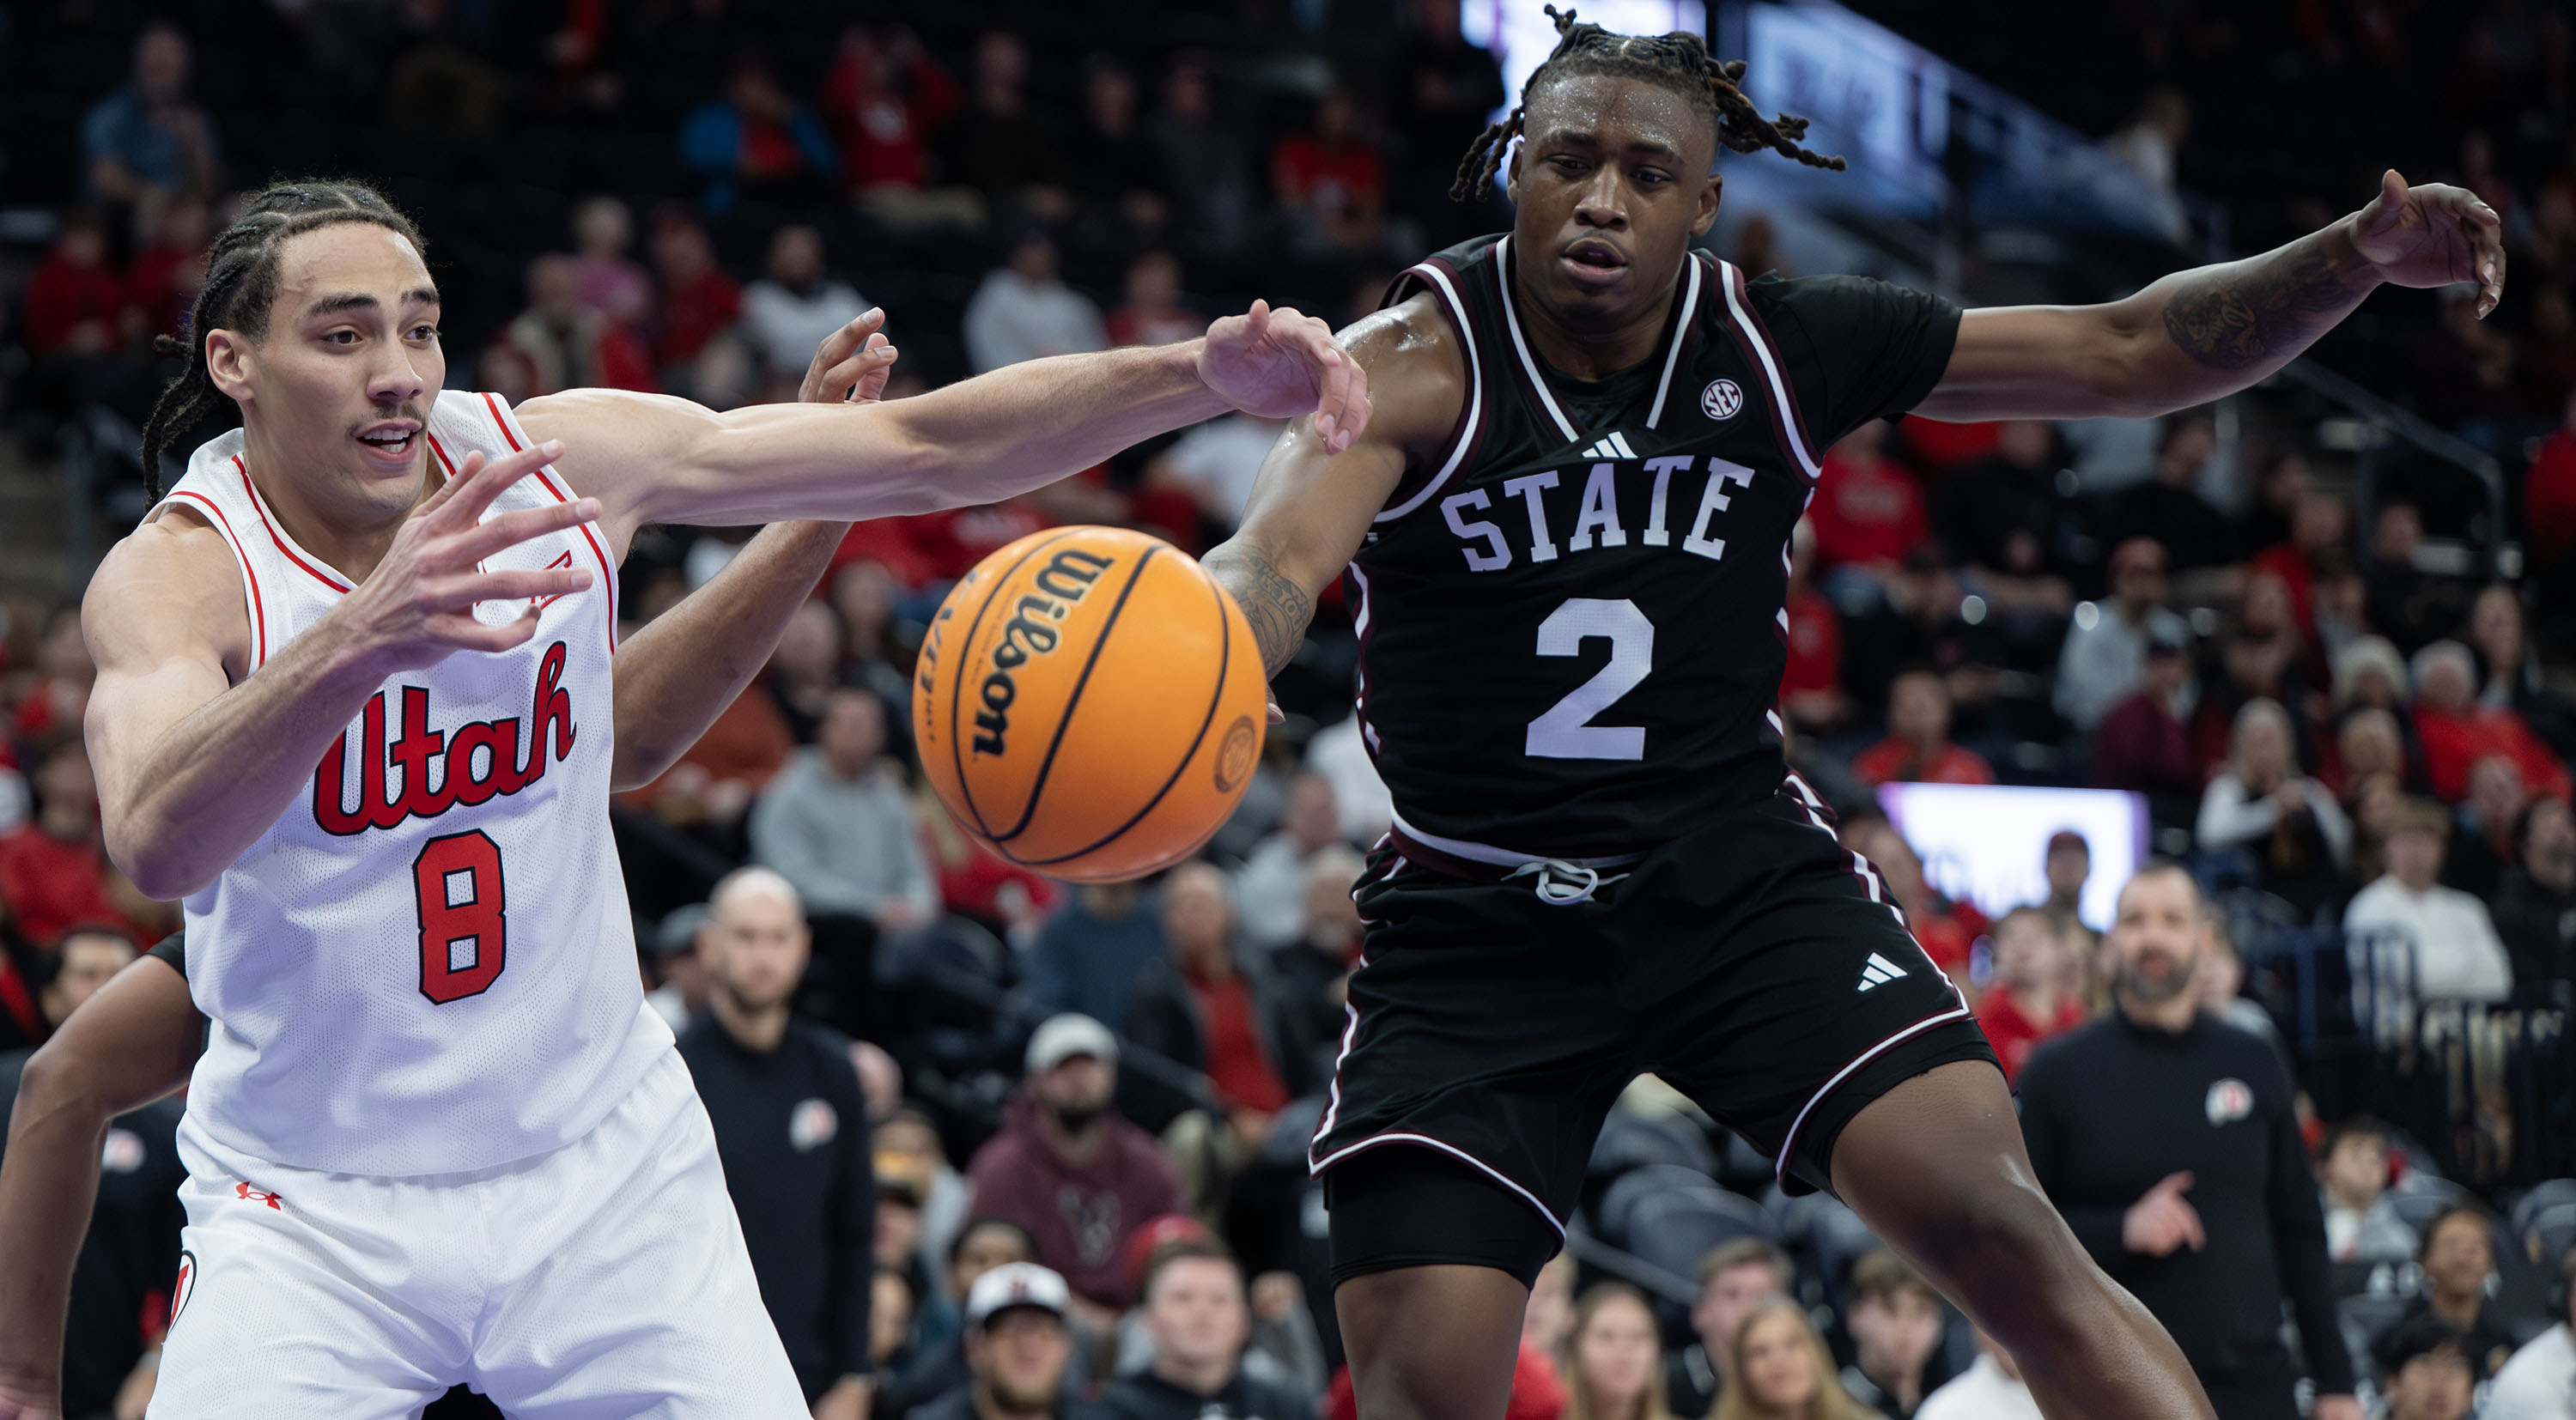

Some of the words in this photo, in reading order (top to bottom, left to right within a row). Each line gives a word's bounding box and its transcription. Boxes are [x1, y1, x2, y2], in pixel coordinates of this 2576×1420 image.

[1704, 381, 1740, 417] SEC
[1439, 455, 1756, 573] STATE
[313, 640, 577, 836] Utah
[970, 549, 1116, 757] Wilson
[1525, 598, 1656, 762] 2
[412, 828, 507, 1005] 8
